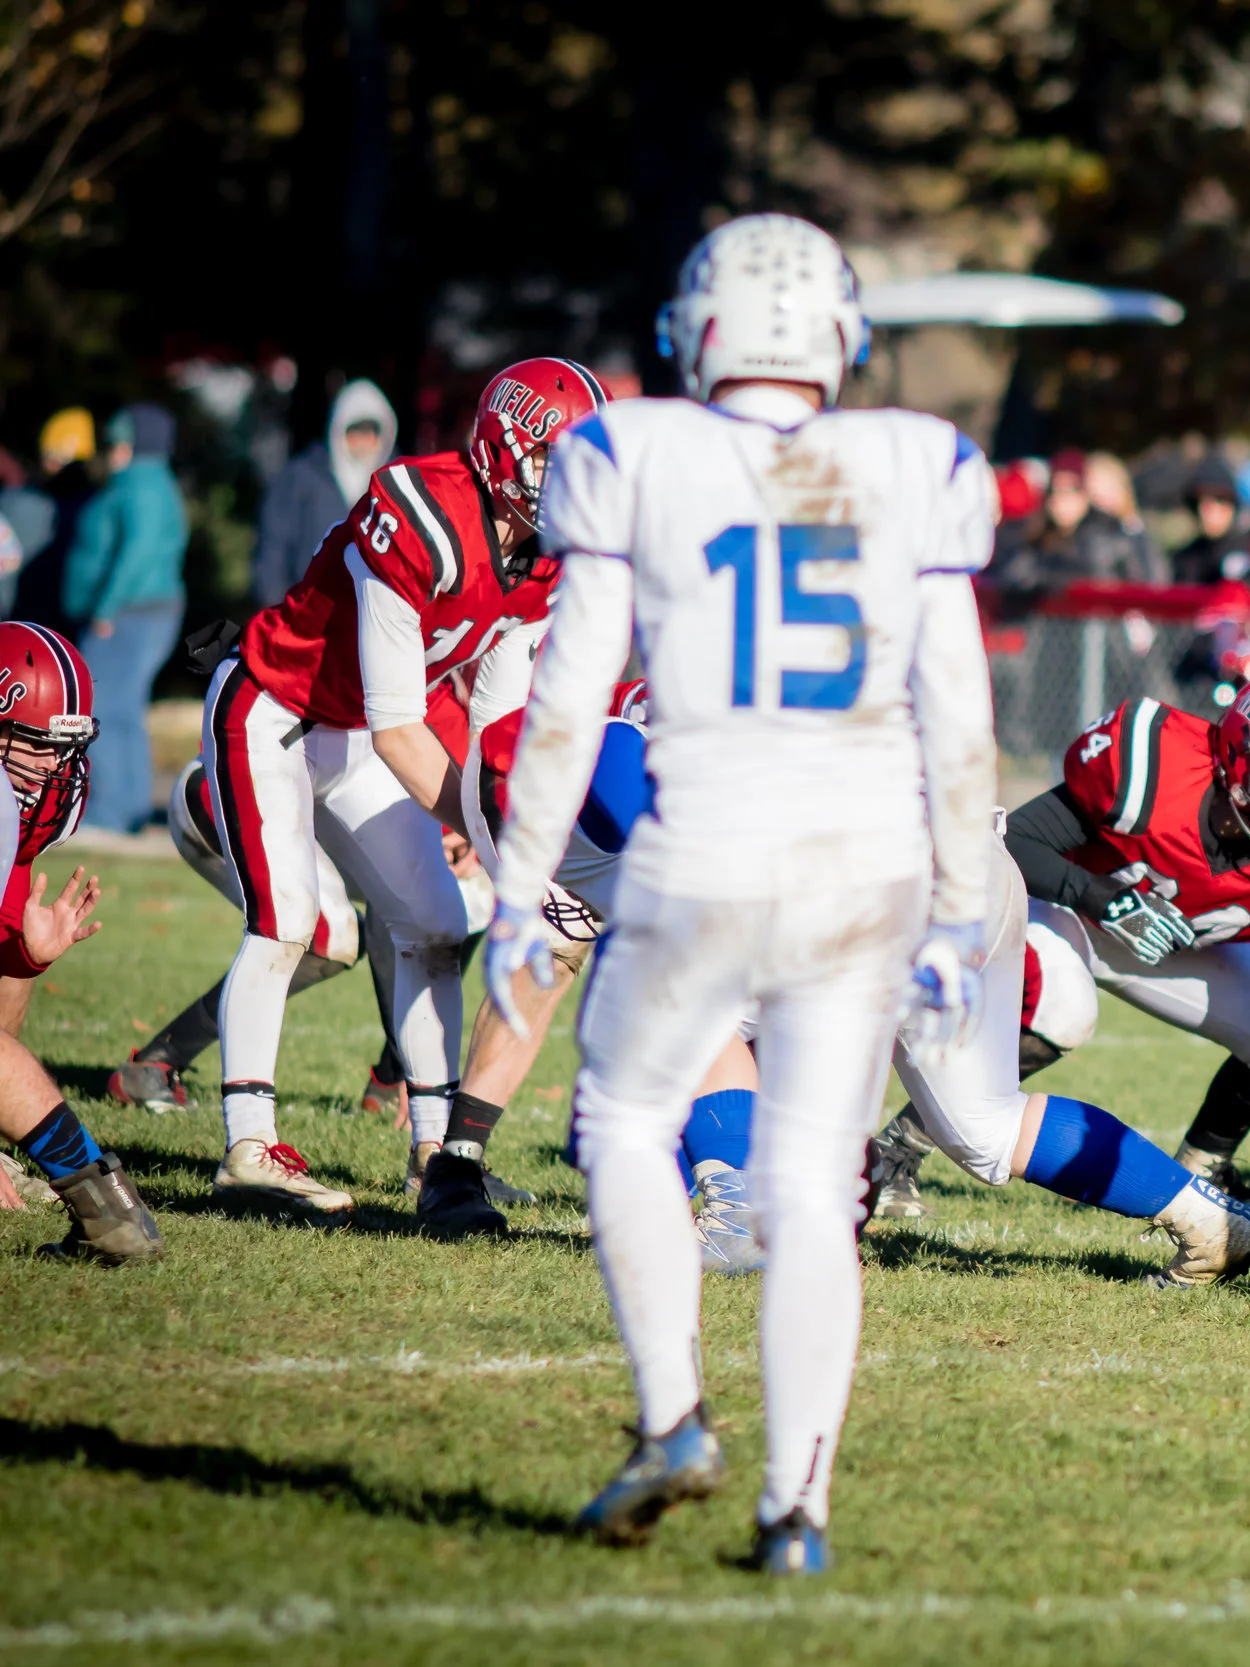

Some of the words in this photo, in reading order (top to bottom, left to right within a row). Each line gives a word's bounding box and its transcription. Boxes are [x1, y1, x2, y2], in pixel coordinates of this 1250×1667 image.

[489, 377, 562, 442] WELLS
[359, 496, 399, 554] 16
[702, 523, 868, 711] 15
